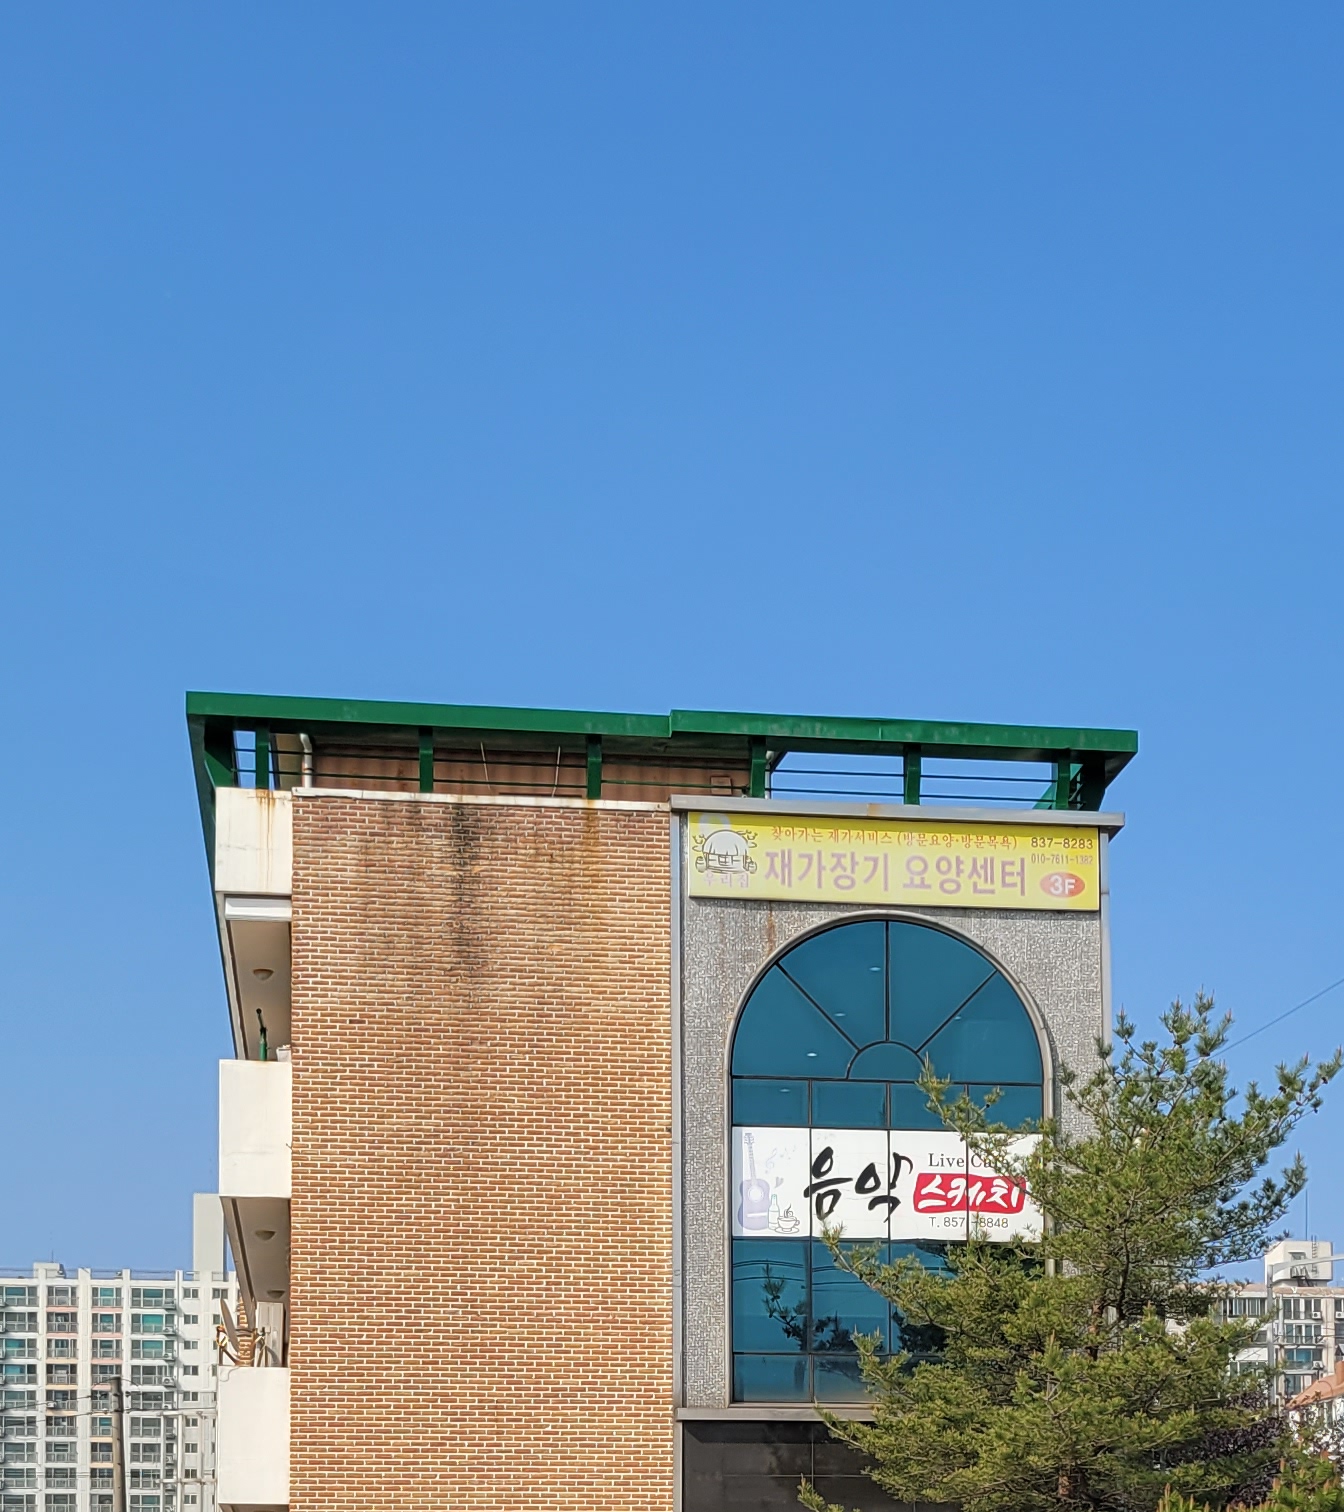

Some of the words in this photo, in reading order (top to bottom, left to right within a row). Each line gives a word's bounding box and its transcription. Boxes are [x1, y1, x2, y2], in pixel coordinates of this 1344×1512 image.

[771, 826, 824, 843] 찾아가는
[828, 828, 892, 846] 재가서비스
[1030, 836, 1094, 850] 837-8283
[764, 848, 889, 893] 재가장기
[902, 854, 1026, 897] 요양센터
[1049, 874, 1076, 896] 3F
[928, 1152, 965, 1168] Live
[917, 1174, 1020, 1210] 스케치
